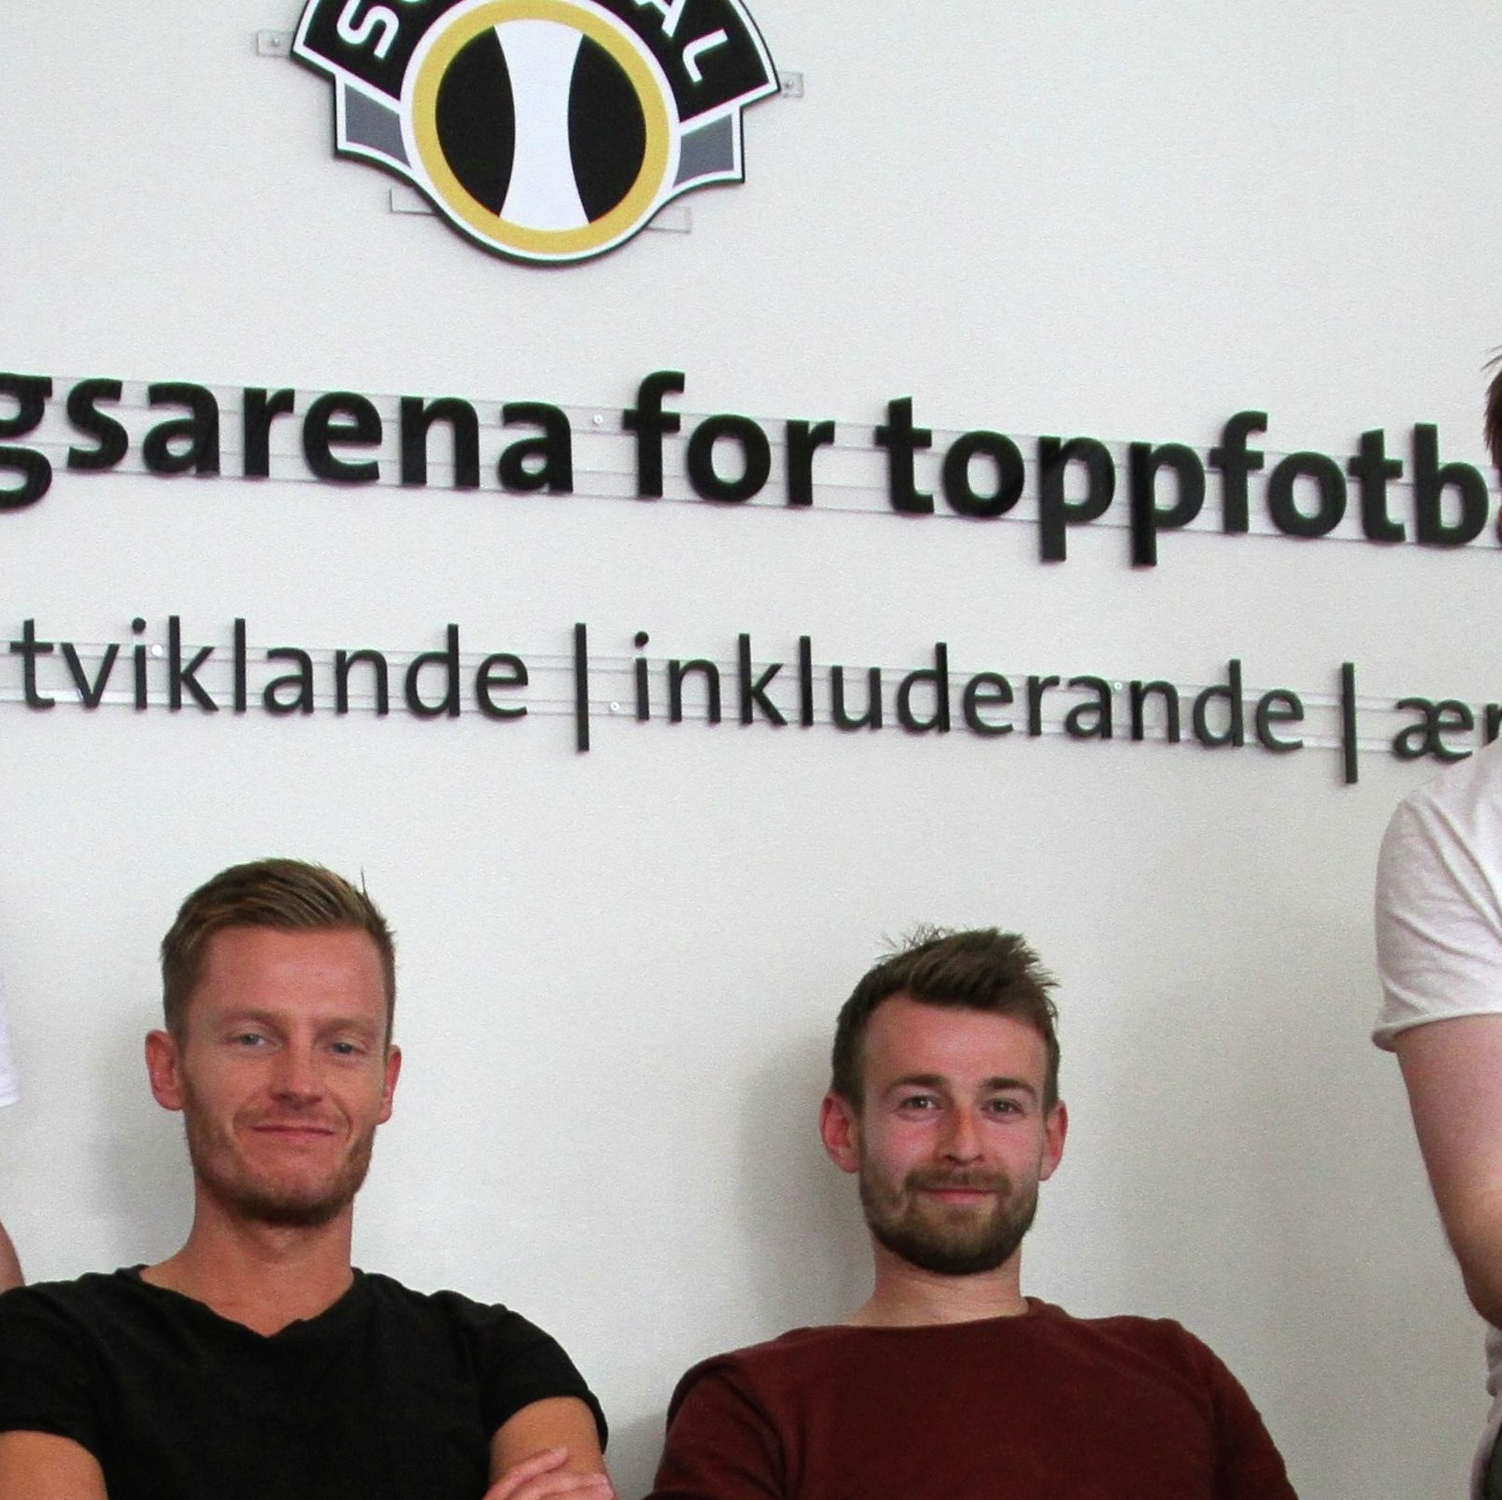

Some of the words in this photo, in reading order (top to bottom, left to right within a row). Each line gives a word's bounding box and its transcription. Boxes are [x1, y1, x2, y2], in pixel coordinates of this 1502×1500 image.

[621, 371, 836, 510] for
[873, 397, 1490, 569] toppfotb
[634, 630, 1305, 755] inkluderande
